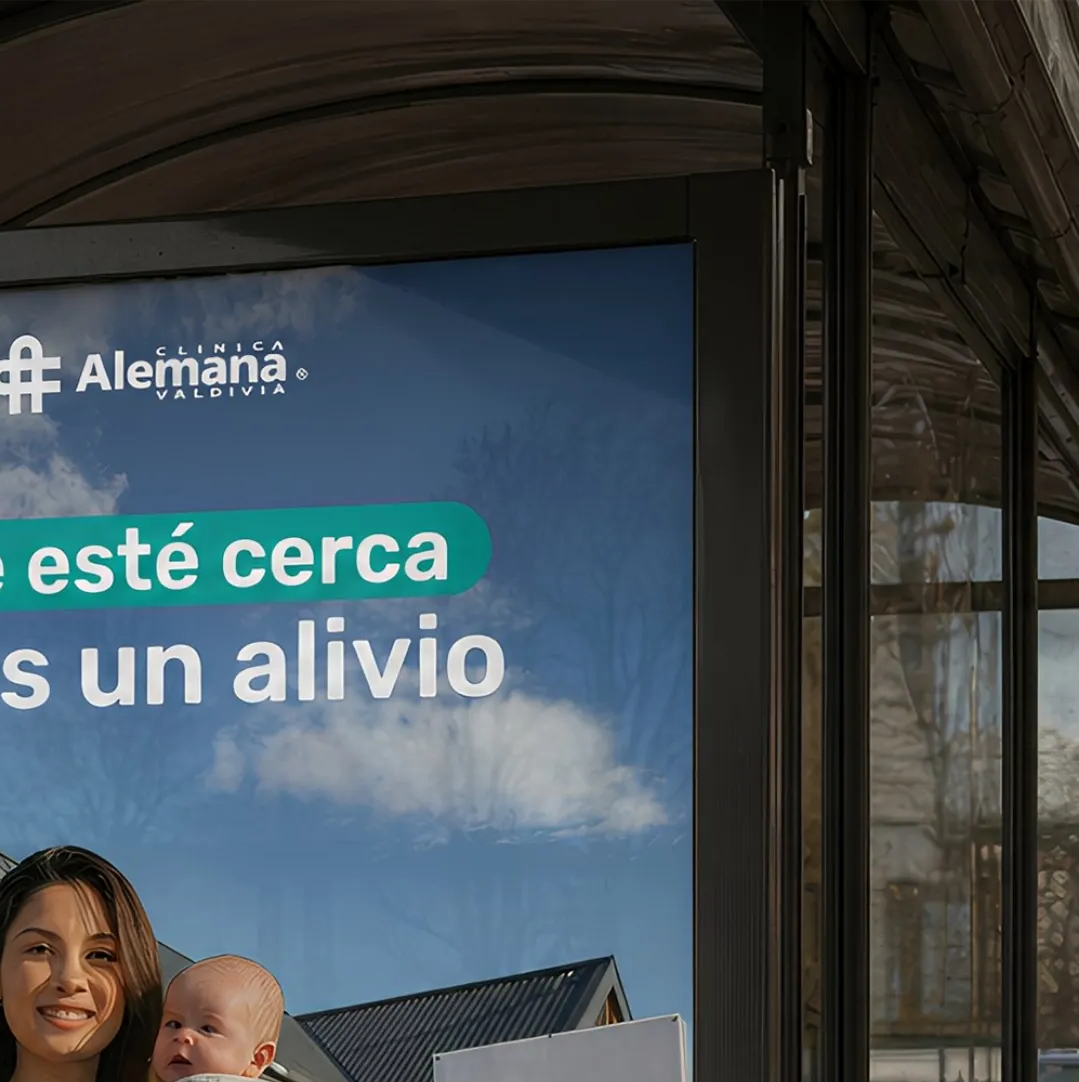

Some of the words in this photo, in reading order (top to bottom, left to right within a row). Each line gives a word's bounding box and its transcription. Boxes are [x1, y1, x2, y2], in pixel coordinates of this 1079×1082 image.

[155, 340, 284, 356] CLINICA
[75, 350, 287, 392] Alemana
[155, 383, 286, 400] VALDIVIA
[27, 522, 199, 594] esté
[222, 531, 448, 587] cerca
[81, 645, 202, 707] un
[233, 613, 505, 703] alivio
